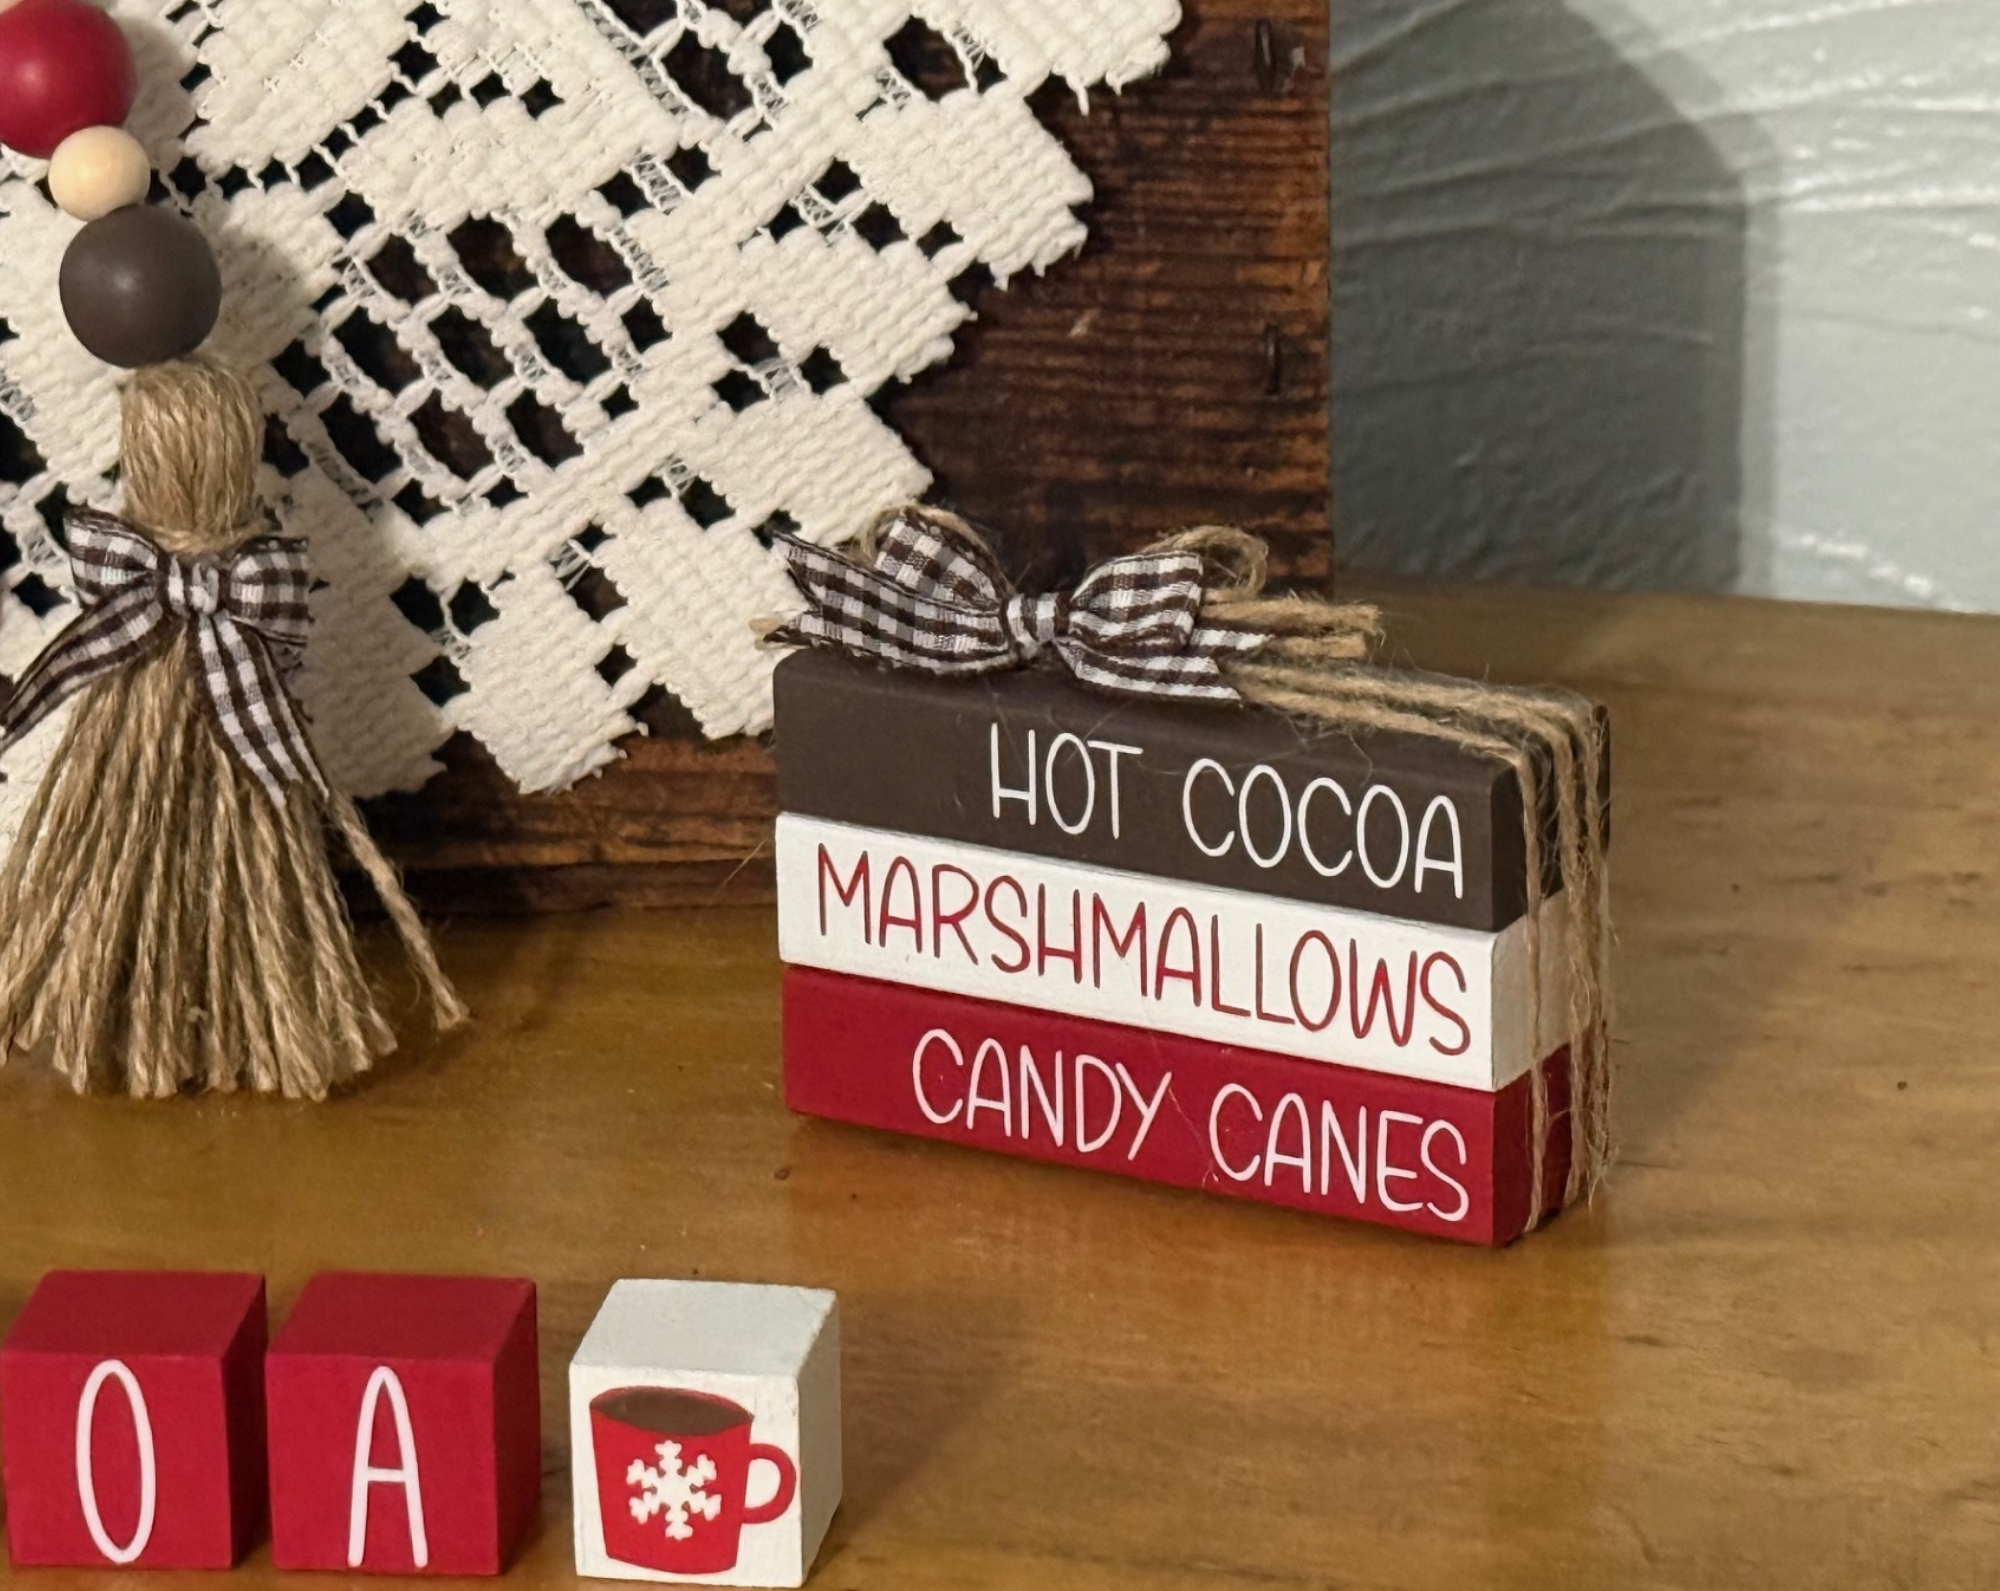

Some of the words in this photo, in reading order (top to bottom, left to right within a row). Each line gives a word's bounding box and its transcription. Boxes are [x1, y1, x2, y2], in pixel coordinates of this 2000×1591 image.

[989, 722, 1143, 839] HOT
[1182, 757, 1464, 899] COCOA
[816, 842, 1472, 1056] MARSHMALLOWS
[911, 1027, 1172, 1160] CANDY
[1208, 1082, 1470, 1222] CANES
